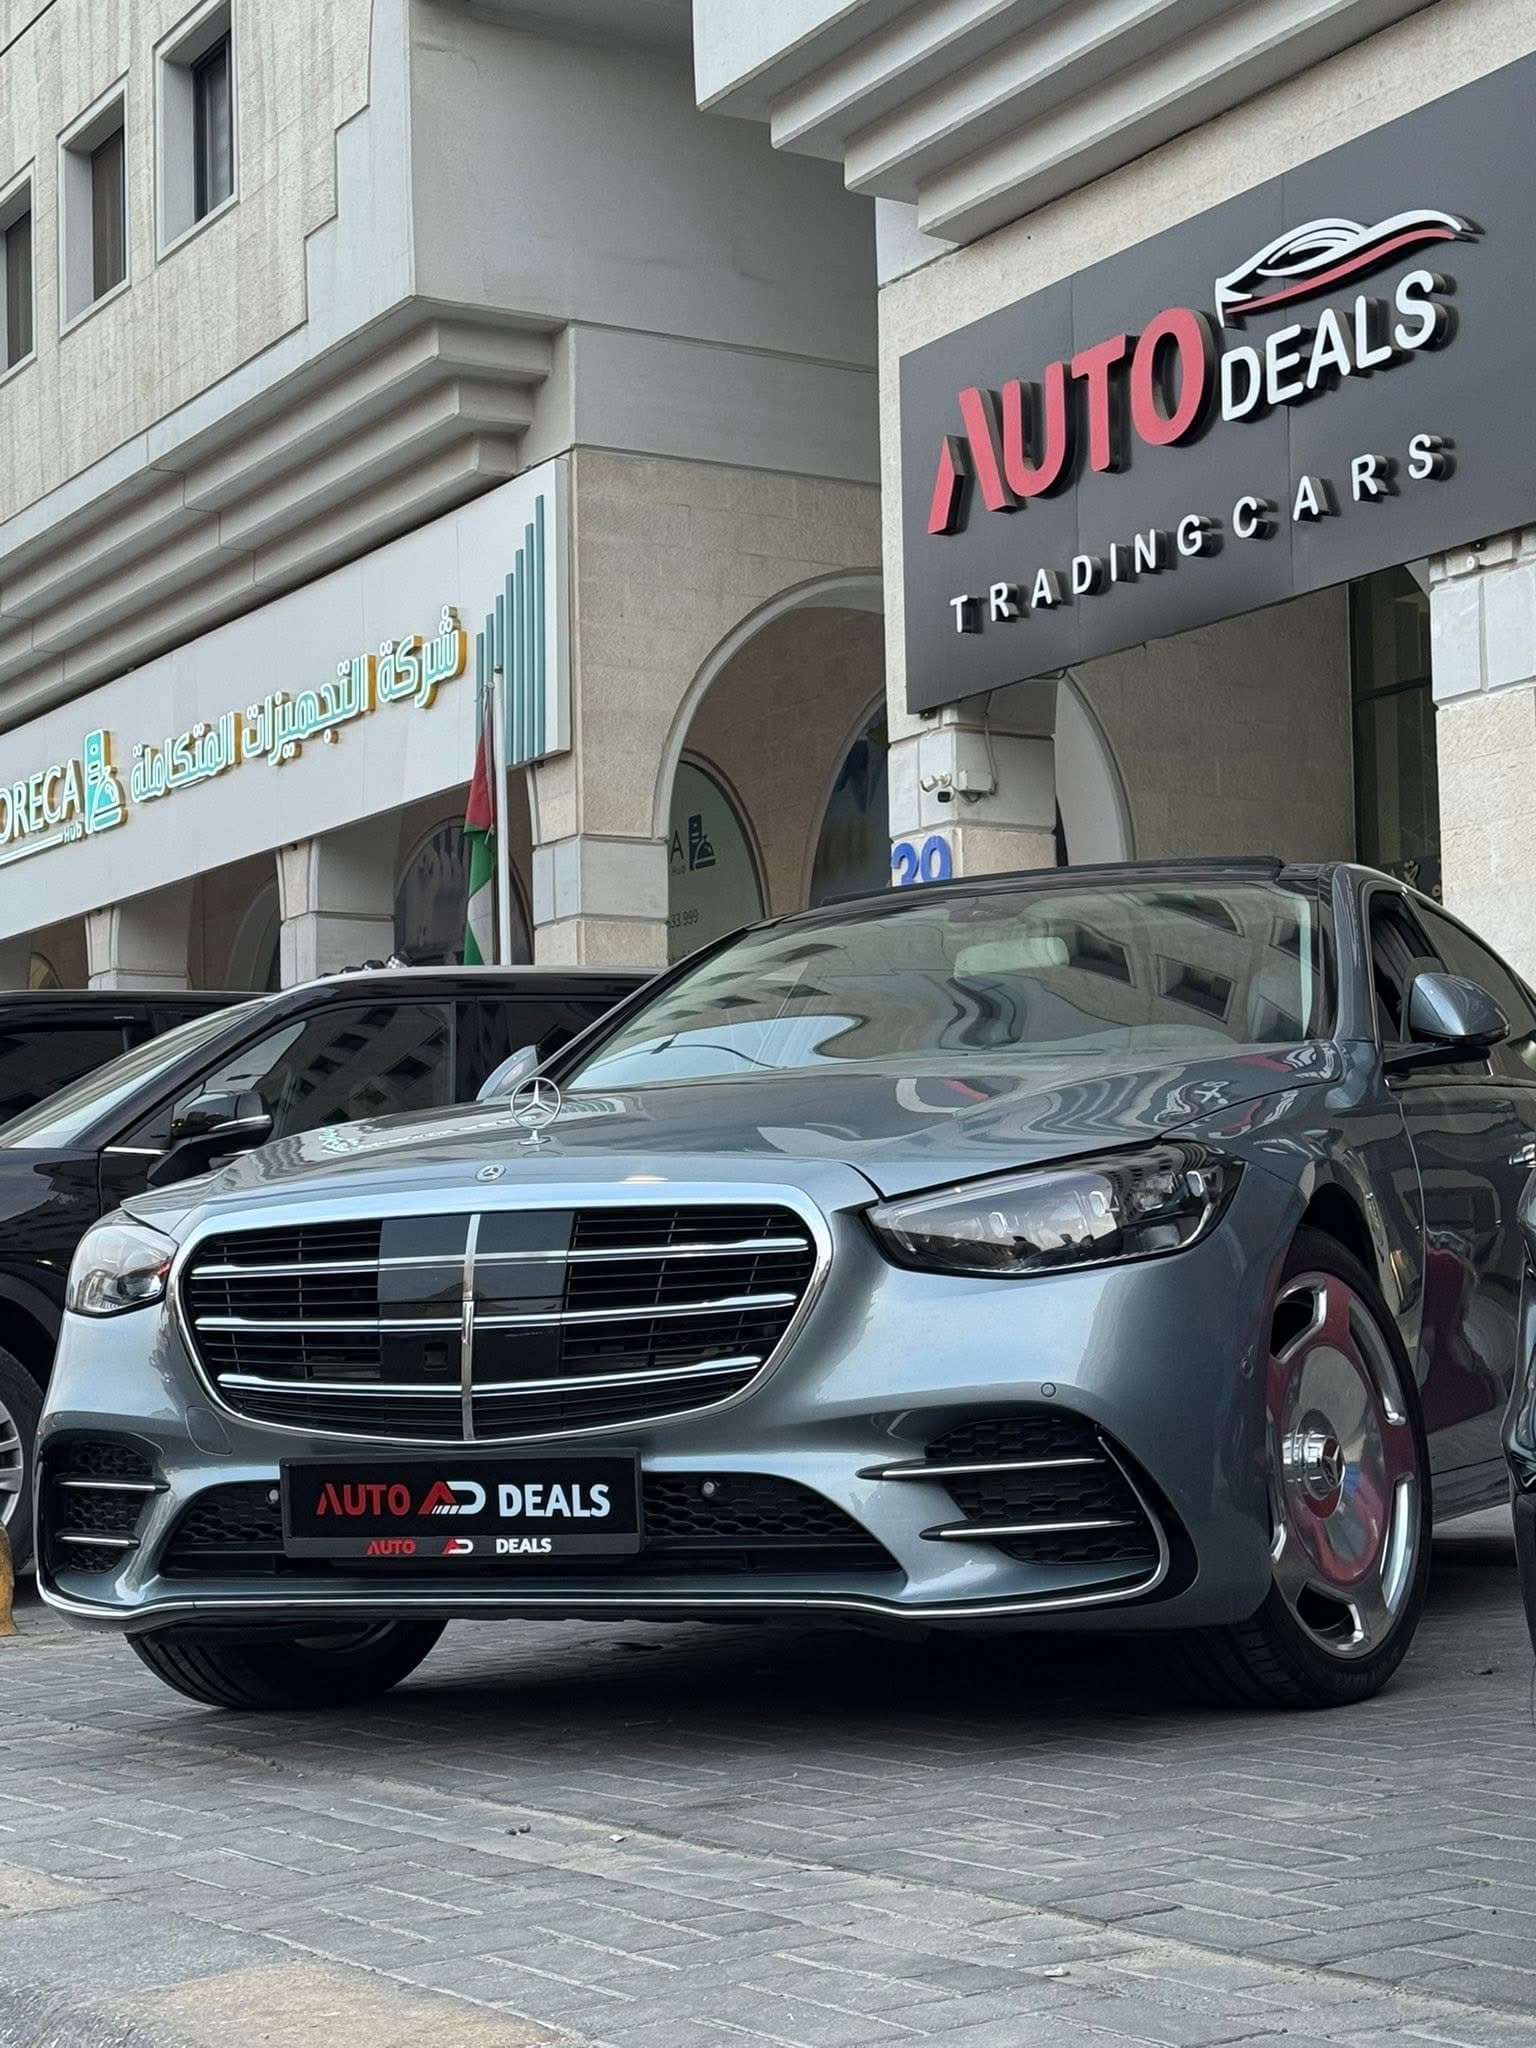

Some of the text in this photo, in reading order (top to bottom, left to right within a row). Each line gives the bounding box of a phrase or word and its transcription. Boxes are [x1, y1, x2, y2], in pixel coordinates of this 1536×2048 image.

[928, 270, 1437, 535] AUTO DEALS
[950, 433, 1441, 634] TRADING CARS
[130, 605, 461, 803] شركة التجهيزات المتكاملة
[316, 1483, 410, 1517] AUTO
[498, 1481, 611, 1518] DEALS
[367, 1539, 416, 1555] AUTO
[496, 1538, 552, 1554] DEALS
